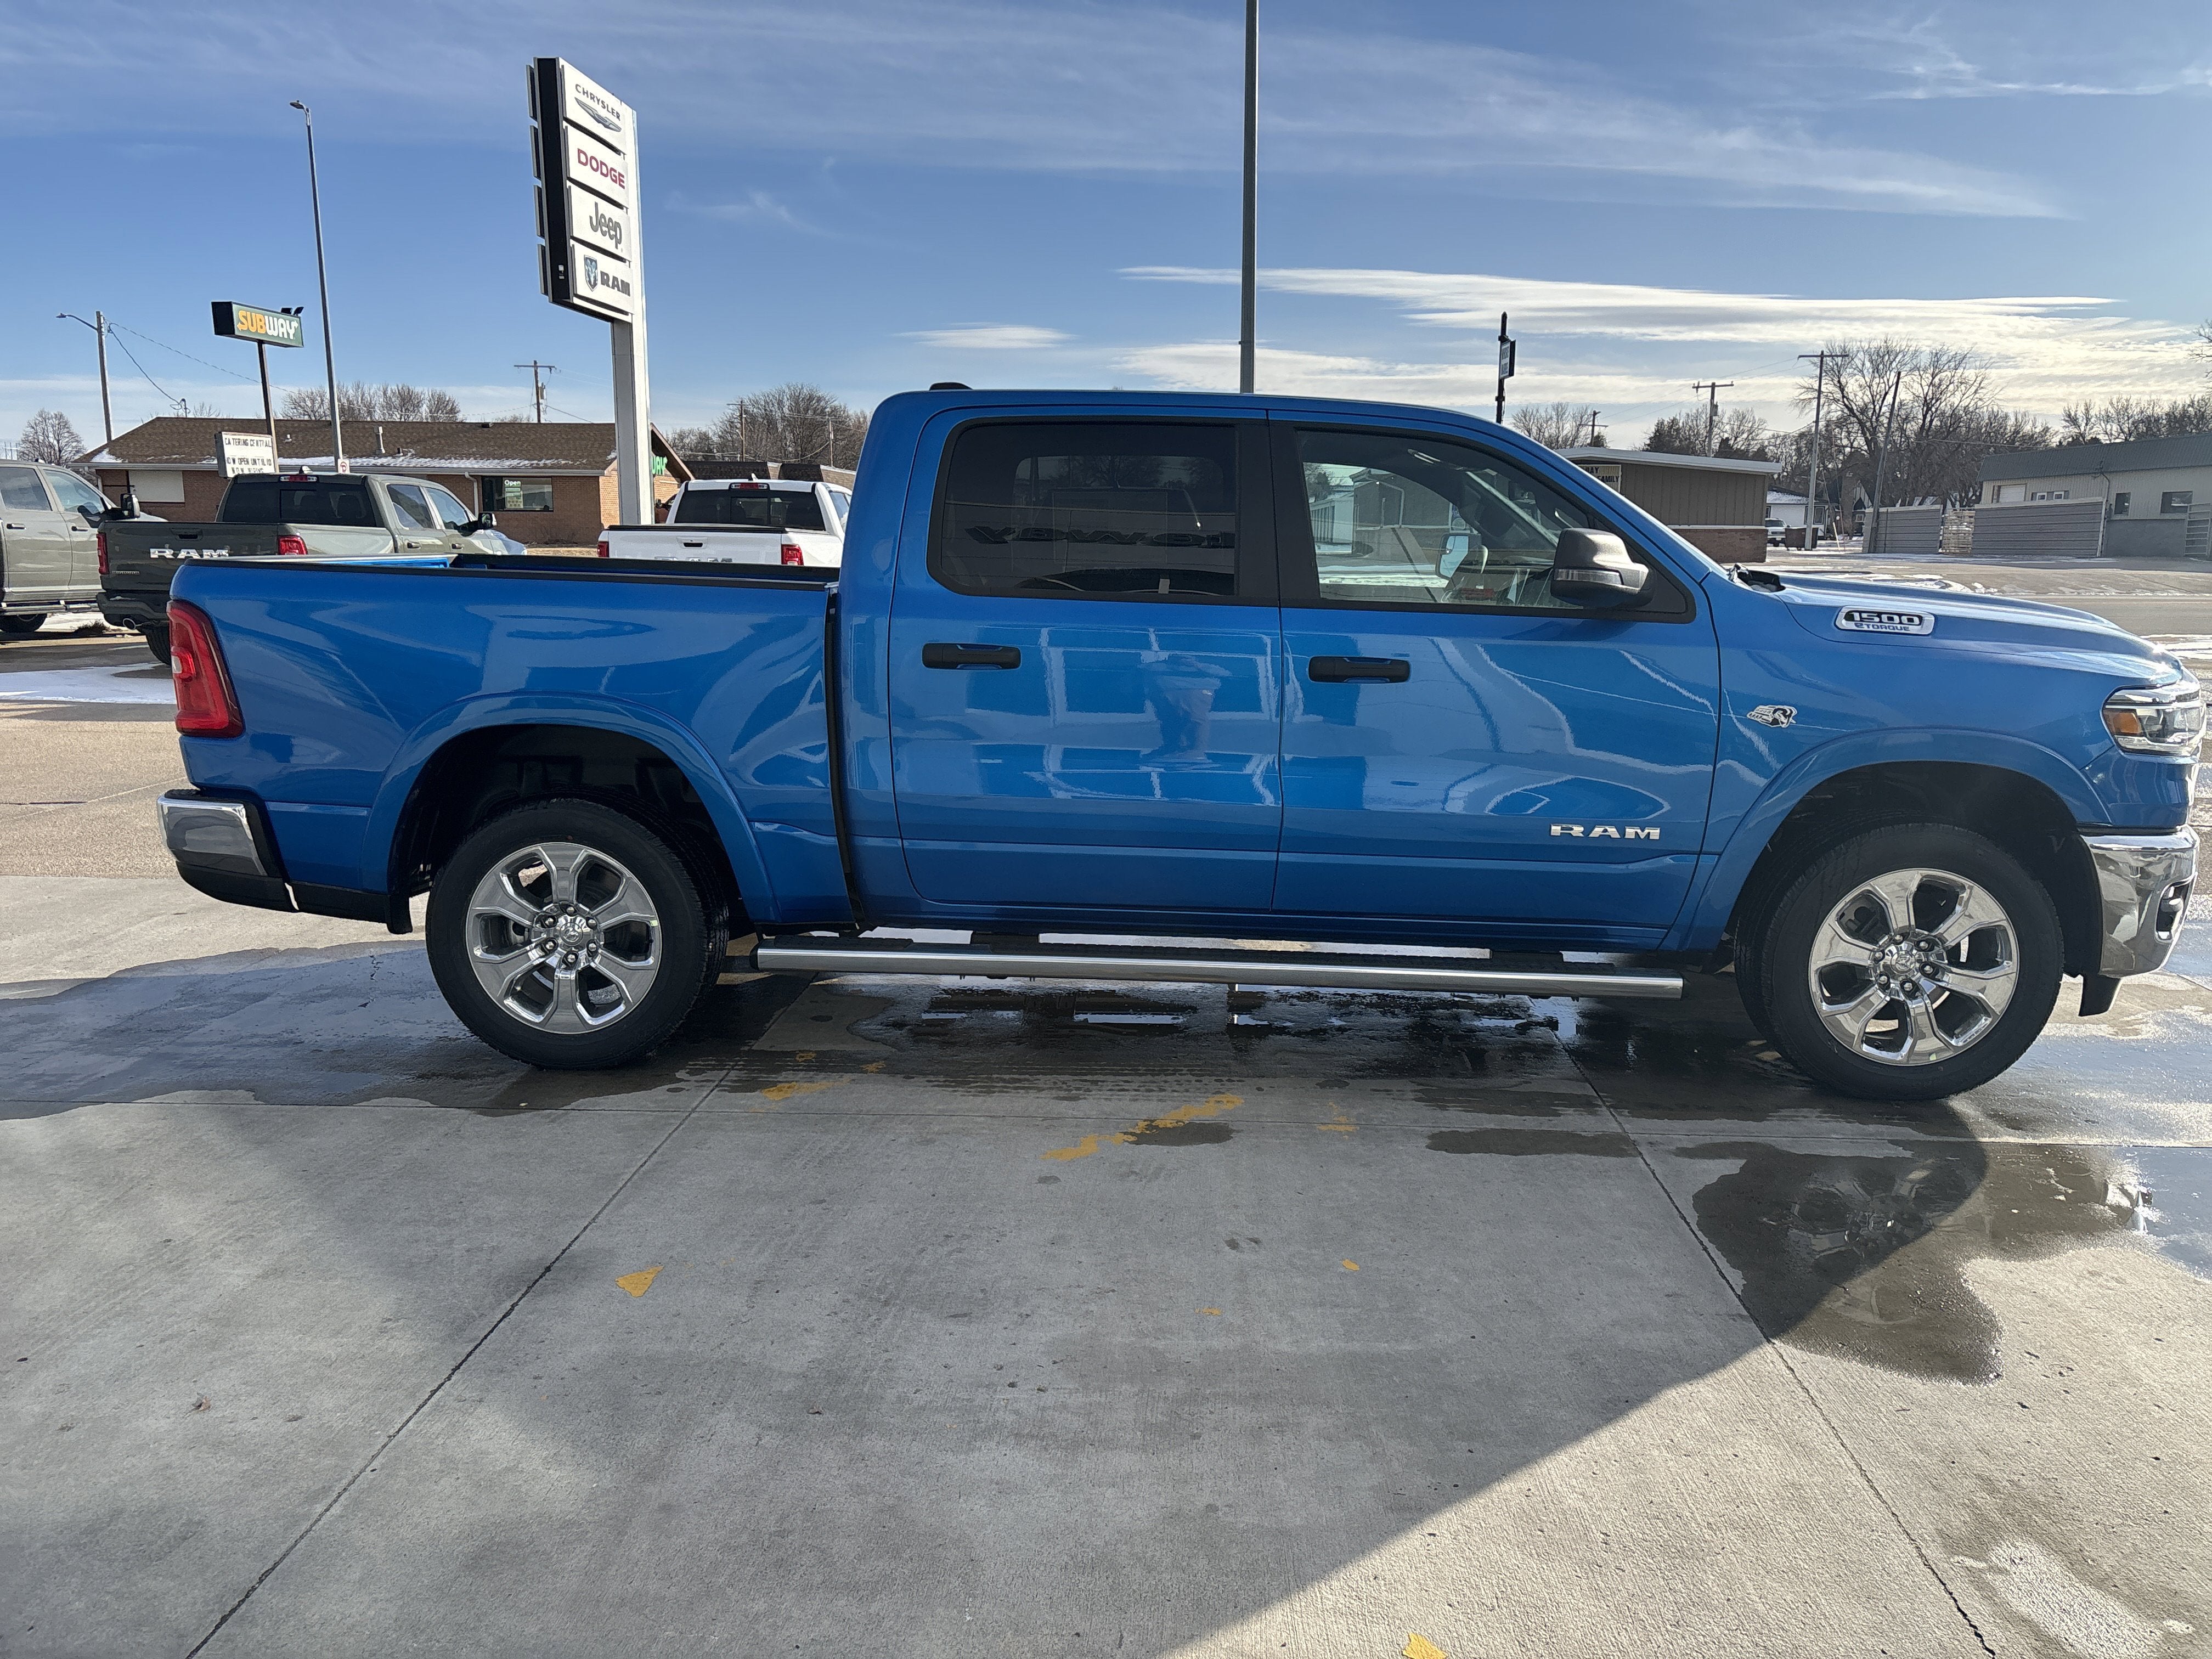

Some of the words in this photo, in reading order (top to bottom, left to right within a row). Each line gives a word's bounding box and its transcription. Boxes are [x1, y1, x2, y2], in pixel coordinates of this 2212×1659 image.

[575, 83, 620, 121] CHRYSLER
[577, 148, 625, 190] DODGE
[589, 201, 623, 250] Jeep
[600, 270, 631, 297] RAM
[237, 310, 298, 340] SUBWAY
[224, 437, 249, 447] CATERING
[250, 438, 272, 448] CENTRAL
[238, 457, 249, 466] OPEN
[149, 548, 229, 559] RAM
[1849, 611, 1921, 625] 1500
[1550, 823, 1661, 840] RAM
